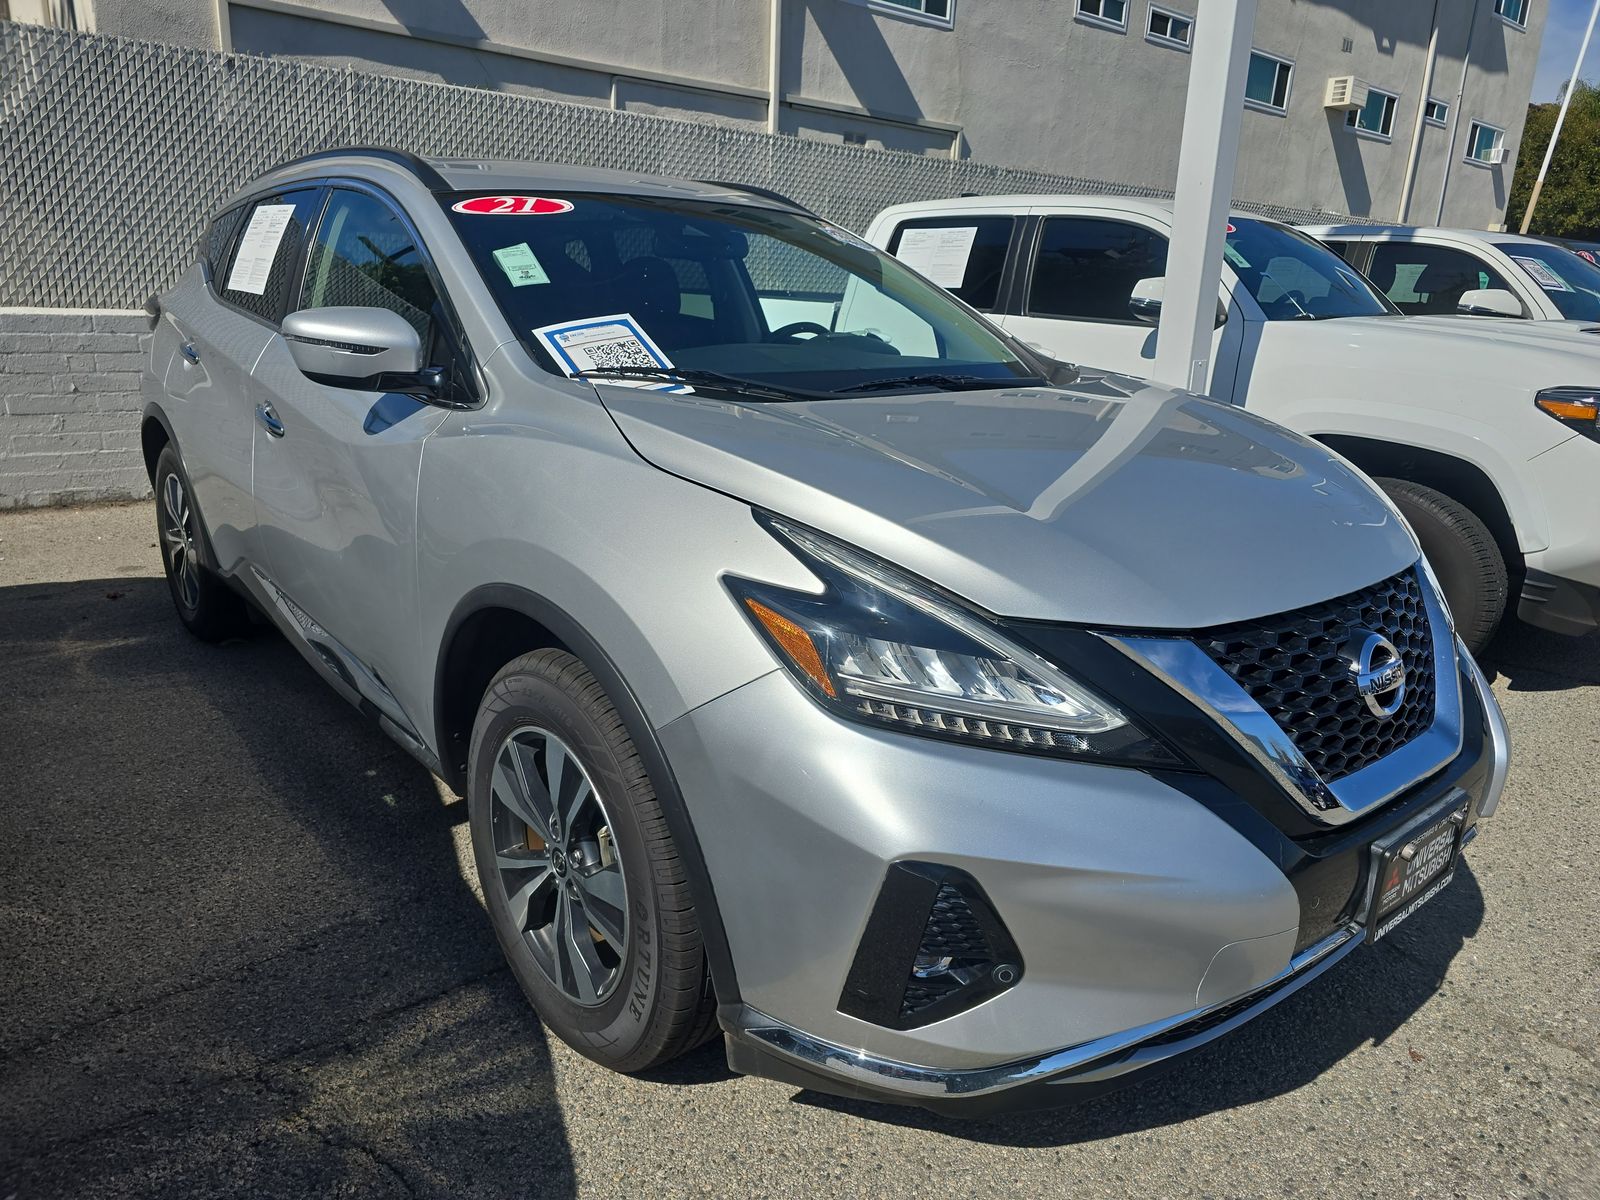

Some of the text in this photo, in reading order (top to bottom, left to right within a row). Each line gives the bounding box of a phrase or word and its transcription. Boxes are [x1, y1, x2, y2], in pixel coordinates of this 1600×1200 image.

[489, 198, 538, 213] 21
[1402, 844, 1453, 897] MITSUBISHI
[1406, 824, 1456, 875] UNIVERSAL
[1373, 872, 1454, 942] UNIVERSALMITSUBISHI.COM
